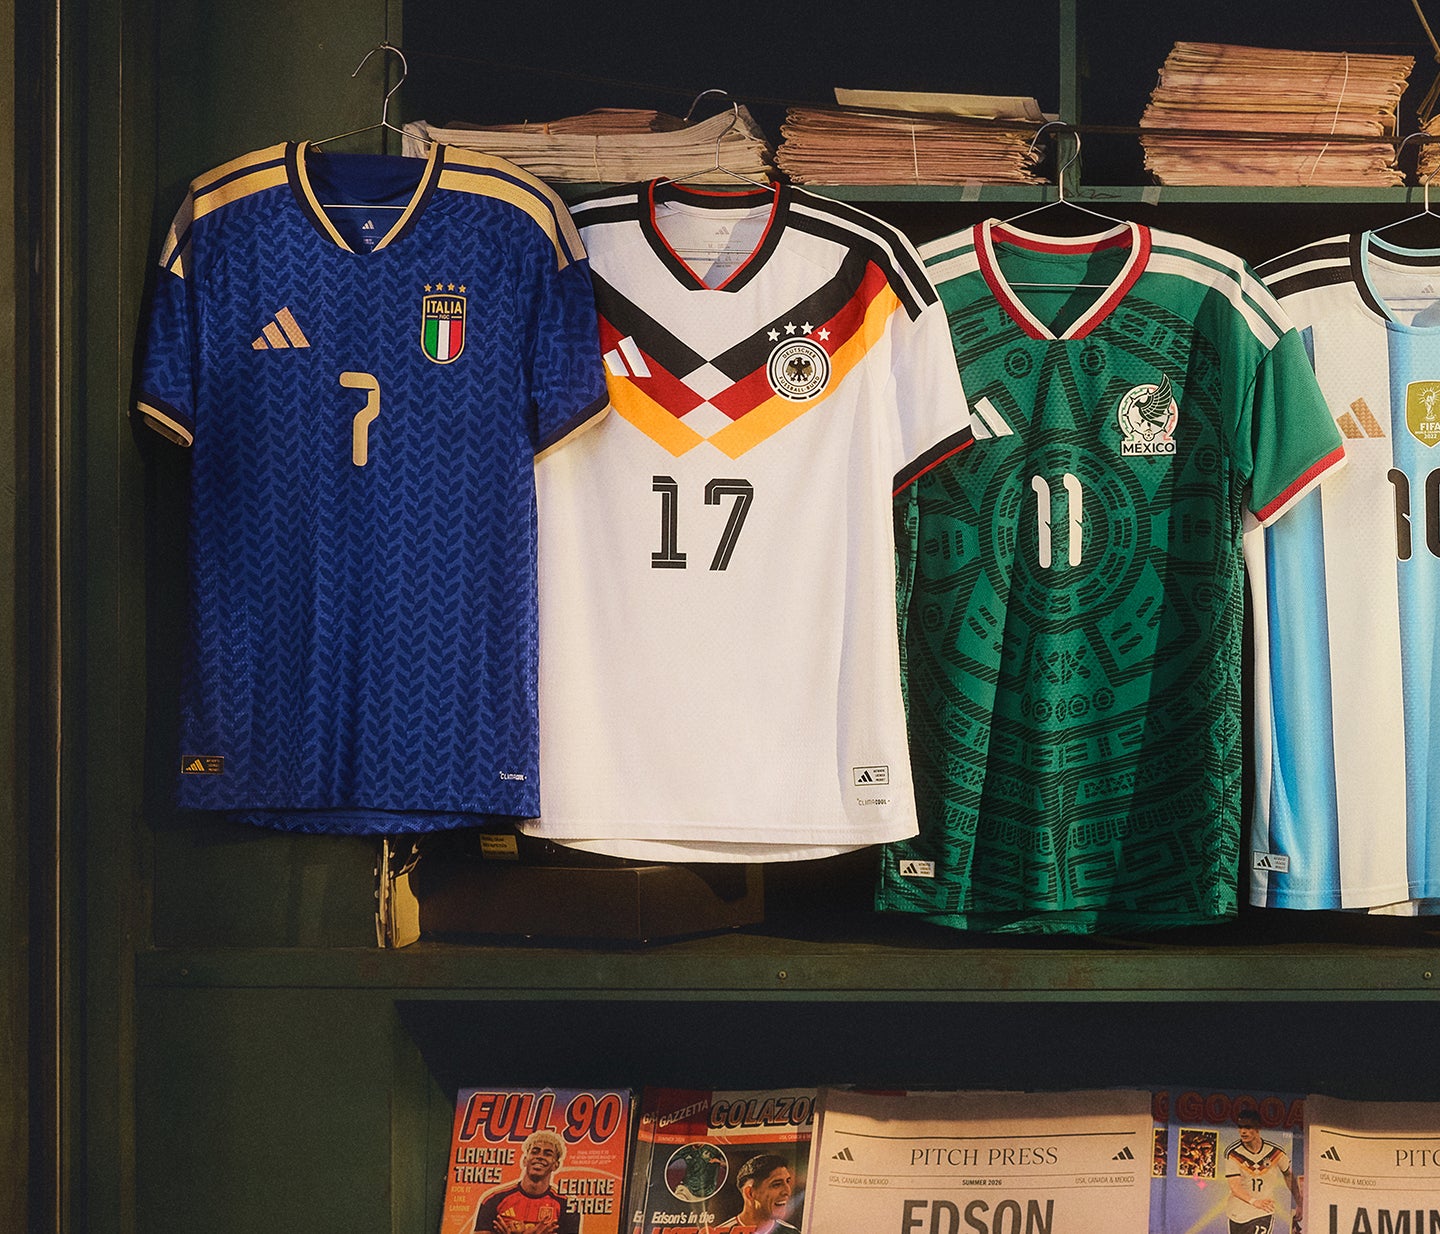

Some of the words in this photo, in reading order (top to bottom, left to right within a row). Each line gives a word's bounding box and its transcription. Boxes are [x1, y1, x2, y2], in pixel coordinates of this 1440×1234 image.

[426, 300, 463, 314] ITALIA
[782, 347, 816, 359] DEUTSCHER
[339, 371, 380, 467] 7
[1123, 440, 1175, 454] MÉXICO
[651, 474, 754, 572] 17
[1031, 472, 1083, 569] 11
[458, 1092, 557, 1143] FULL
[561, 1093, 623, 1144] 90
[659, 1099, 709, 1128] GAZZETTA
[456, 1147, 516, 1165] LAMINE
[910, 1148, 978, 1166] PITCH
[988, 1147, 1058, 1166] PRESS
[454, 1166, 503, 1184] TAKES
[841, 1177, 863, 1185] CANADA
[869, 1178, 889, 1186] MEXICO
[1088, 1176, 1108, 1184] CANADA
[1115, 1175, 1135, 1183] MEXICO
[1331, 1175, 1351, 1184] CANADA
[558, 1178, 615, 1196] CENTRE
[1251, 1178, 1264, 1192] 17
[565, 1194, 613, 1214] STAGE
[651, 1211, 687, 1224] Edson's
[688, 1212, 697, 1224] in
[699, 1211, 715, 1224] the
[901, 1199, 1054, 1234] EDSON
